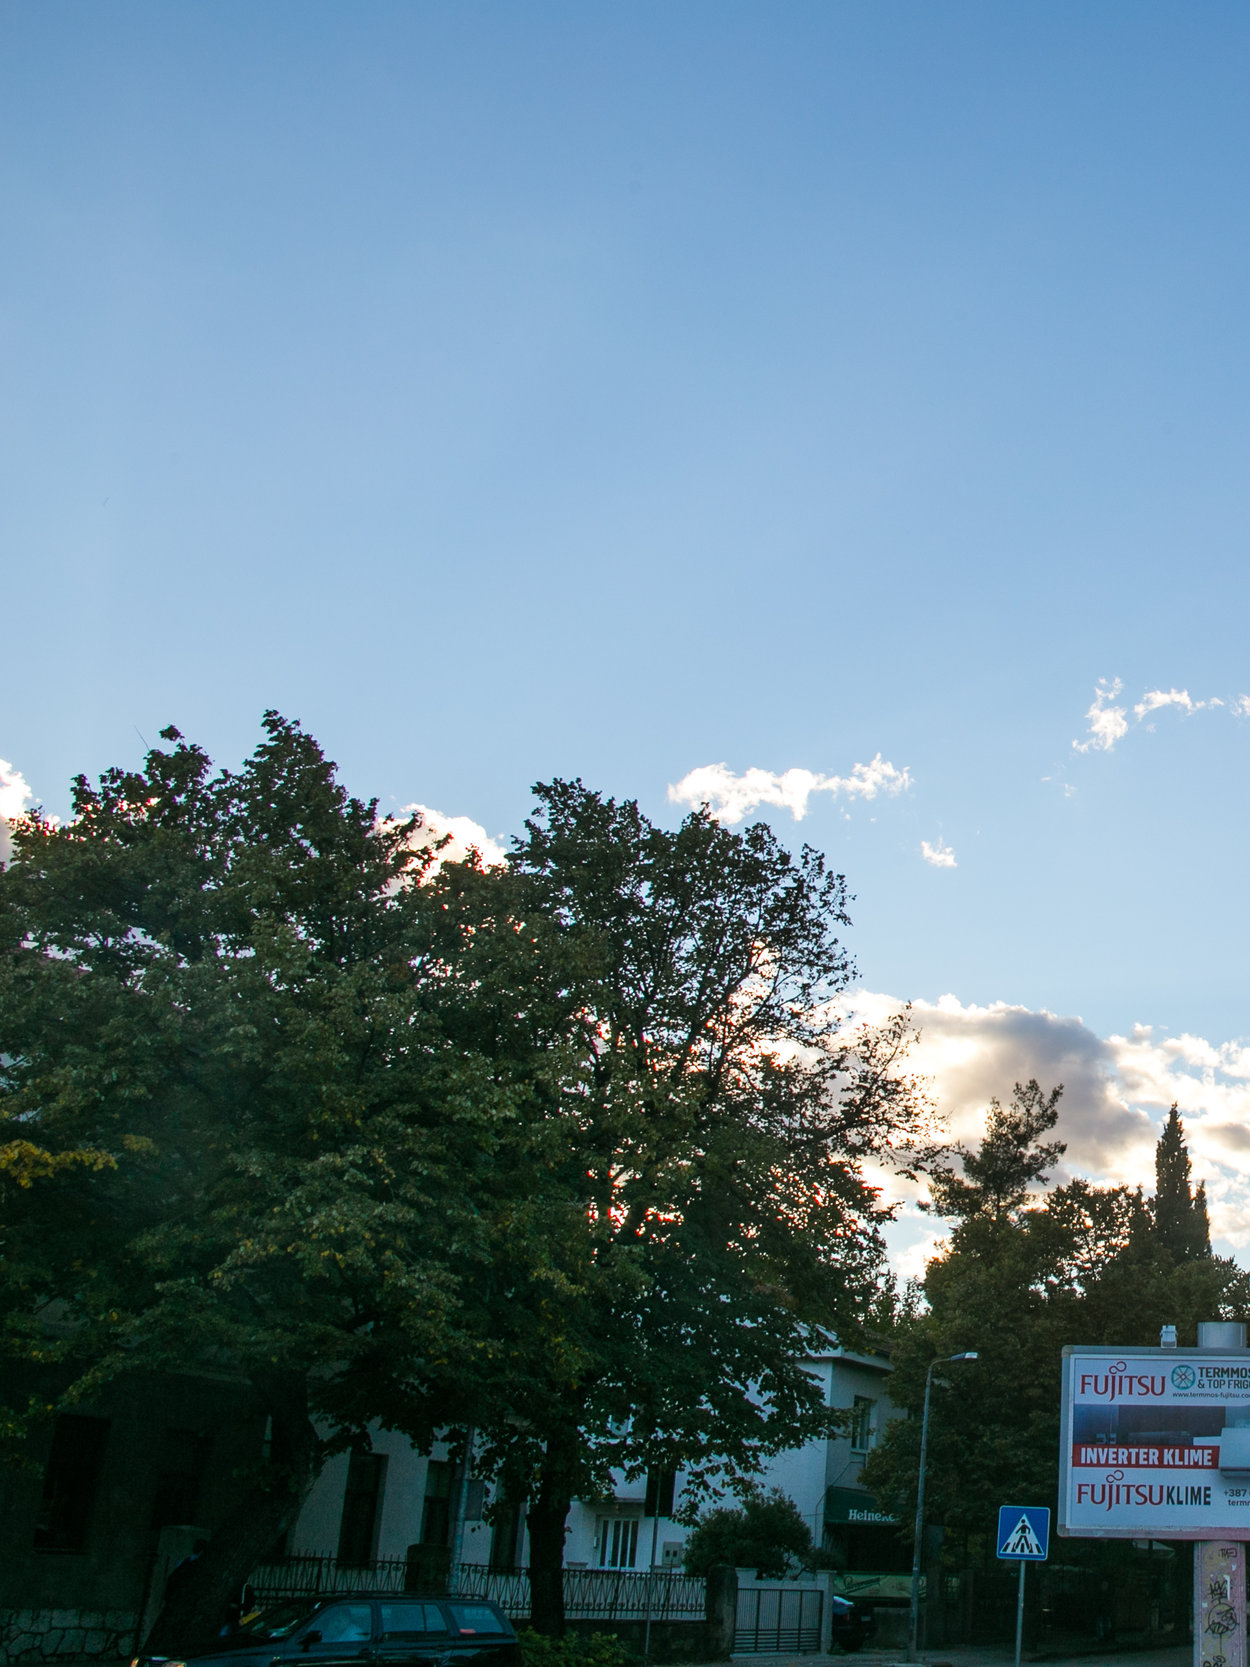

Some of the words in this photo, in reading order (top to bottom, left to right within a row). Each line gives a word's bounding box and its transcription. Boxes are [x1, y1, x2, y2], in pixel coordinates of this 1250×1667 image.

[1080, 1374, 1166, 1402] FUJITSU
[1197, 1379, 1205, 1388] &
[1207, 1379, 1225, 1389] TOP
[1080, 1447, 1159, 1465] INVERTER
[1163, 1448, 1212, 1466] KLIME
[1077, 1483, 1164, 1511] FUJITSU
[1166, 1486, 1212, 1506] KLIME
[1223, 1489, 1249, 1498] +387
